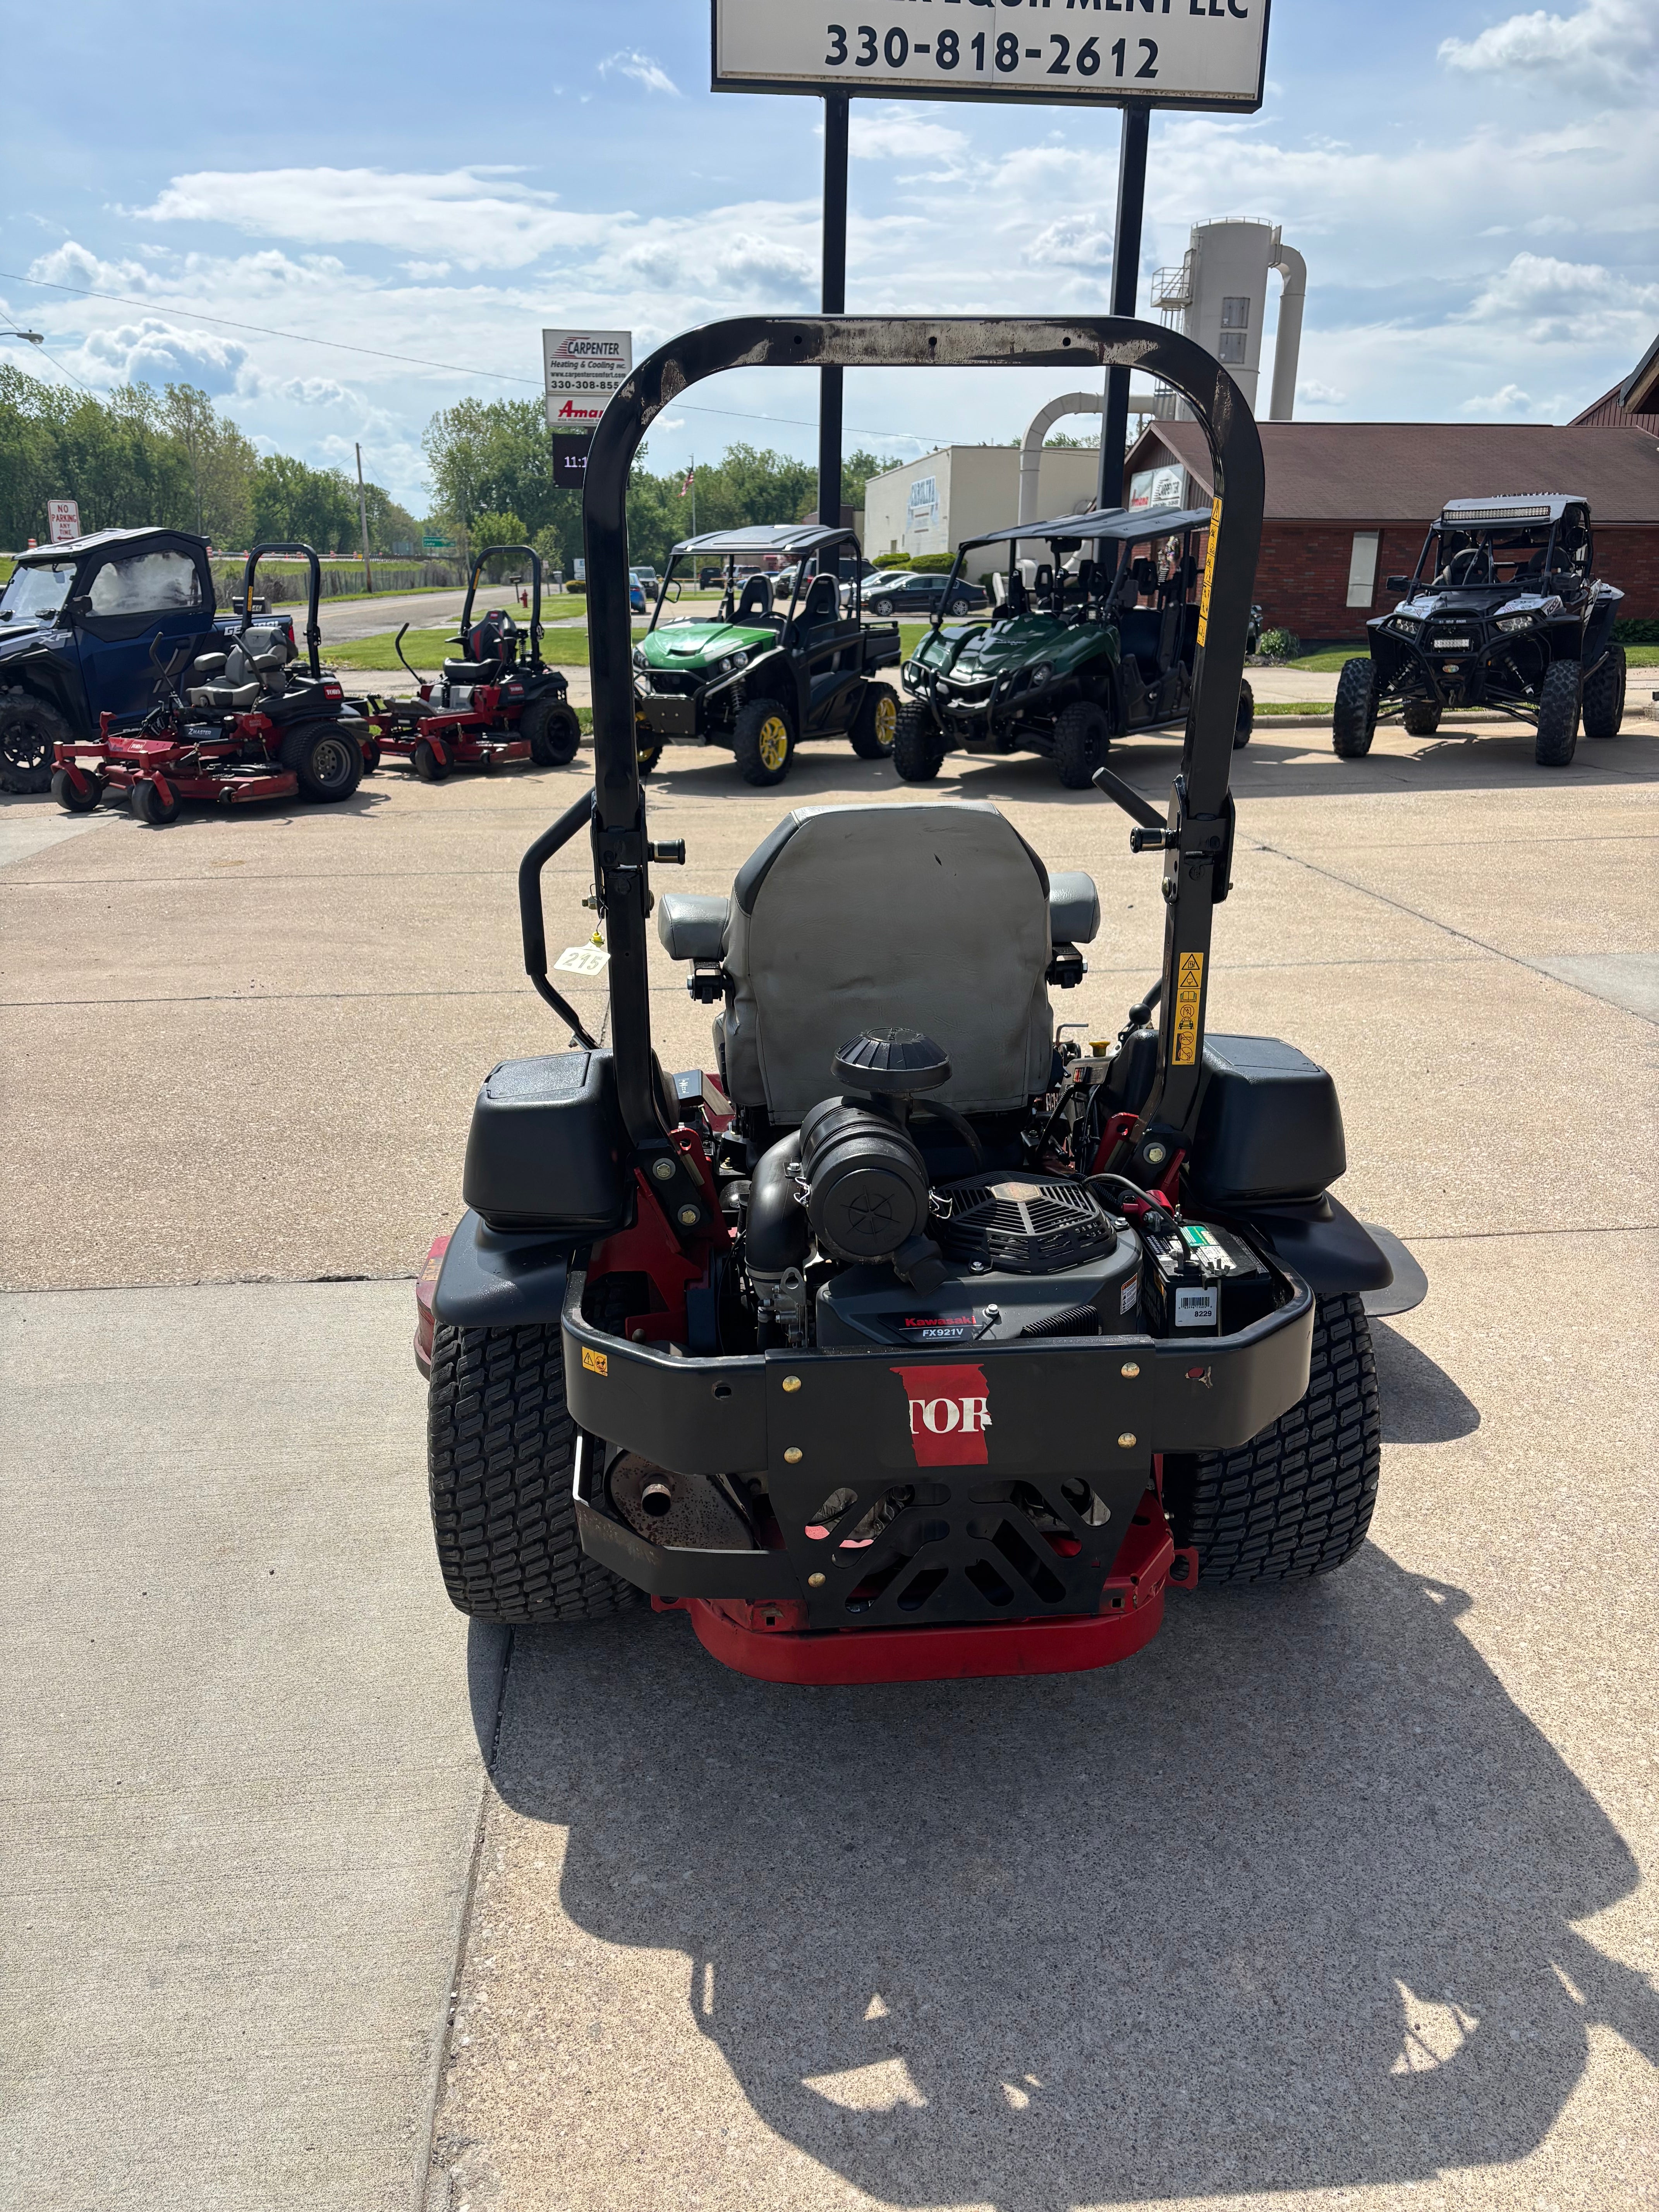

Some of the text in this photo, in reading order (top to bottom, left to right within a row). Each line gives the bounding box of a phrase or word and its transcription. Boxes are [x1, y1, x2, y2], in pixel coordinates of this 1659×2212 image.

[825, 25, 1159, 78] 330-818-2612
[568, 342, 619, 355] CARPENTER
[550, 361, 578, 369] Heating
[588, 361, 615, 370] Cooling
[551, 381, 620, 389] 330-308-855
[564, 456, 587, 467] 11:1
[58, 505, 68, 513] NO
[52, 514, 76, 522] PARKING
[39, 632, 72, 644] XP
[563, 953, 603, 970] 215
[905, 1316, 976, 1326] Kawasaki
[923, 1328, 963, 1336] FX921V
